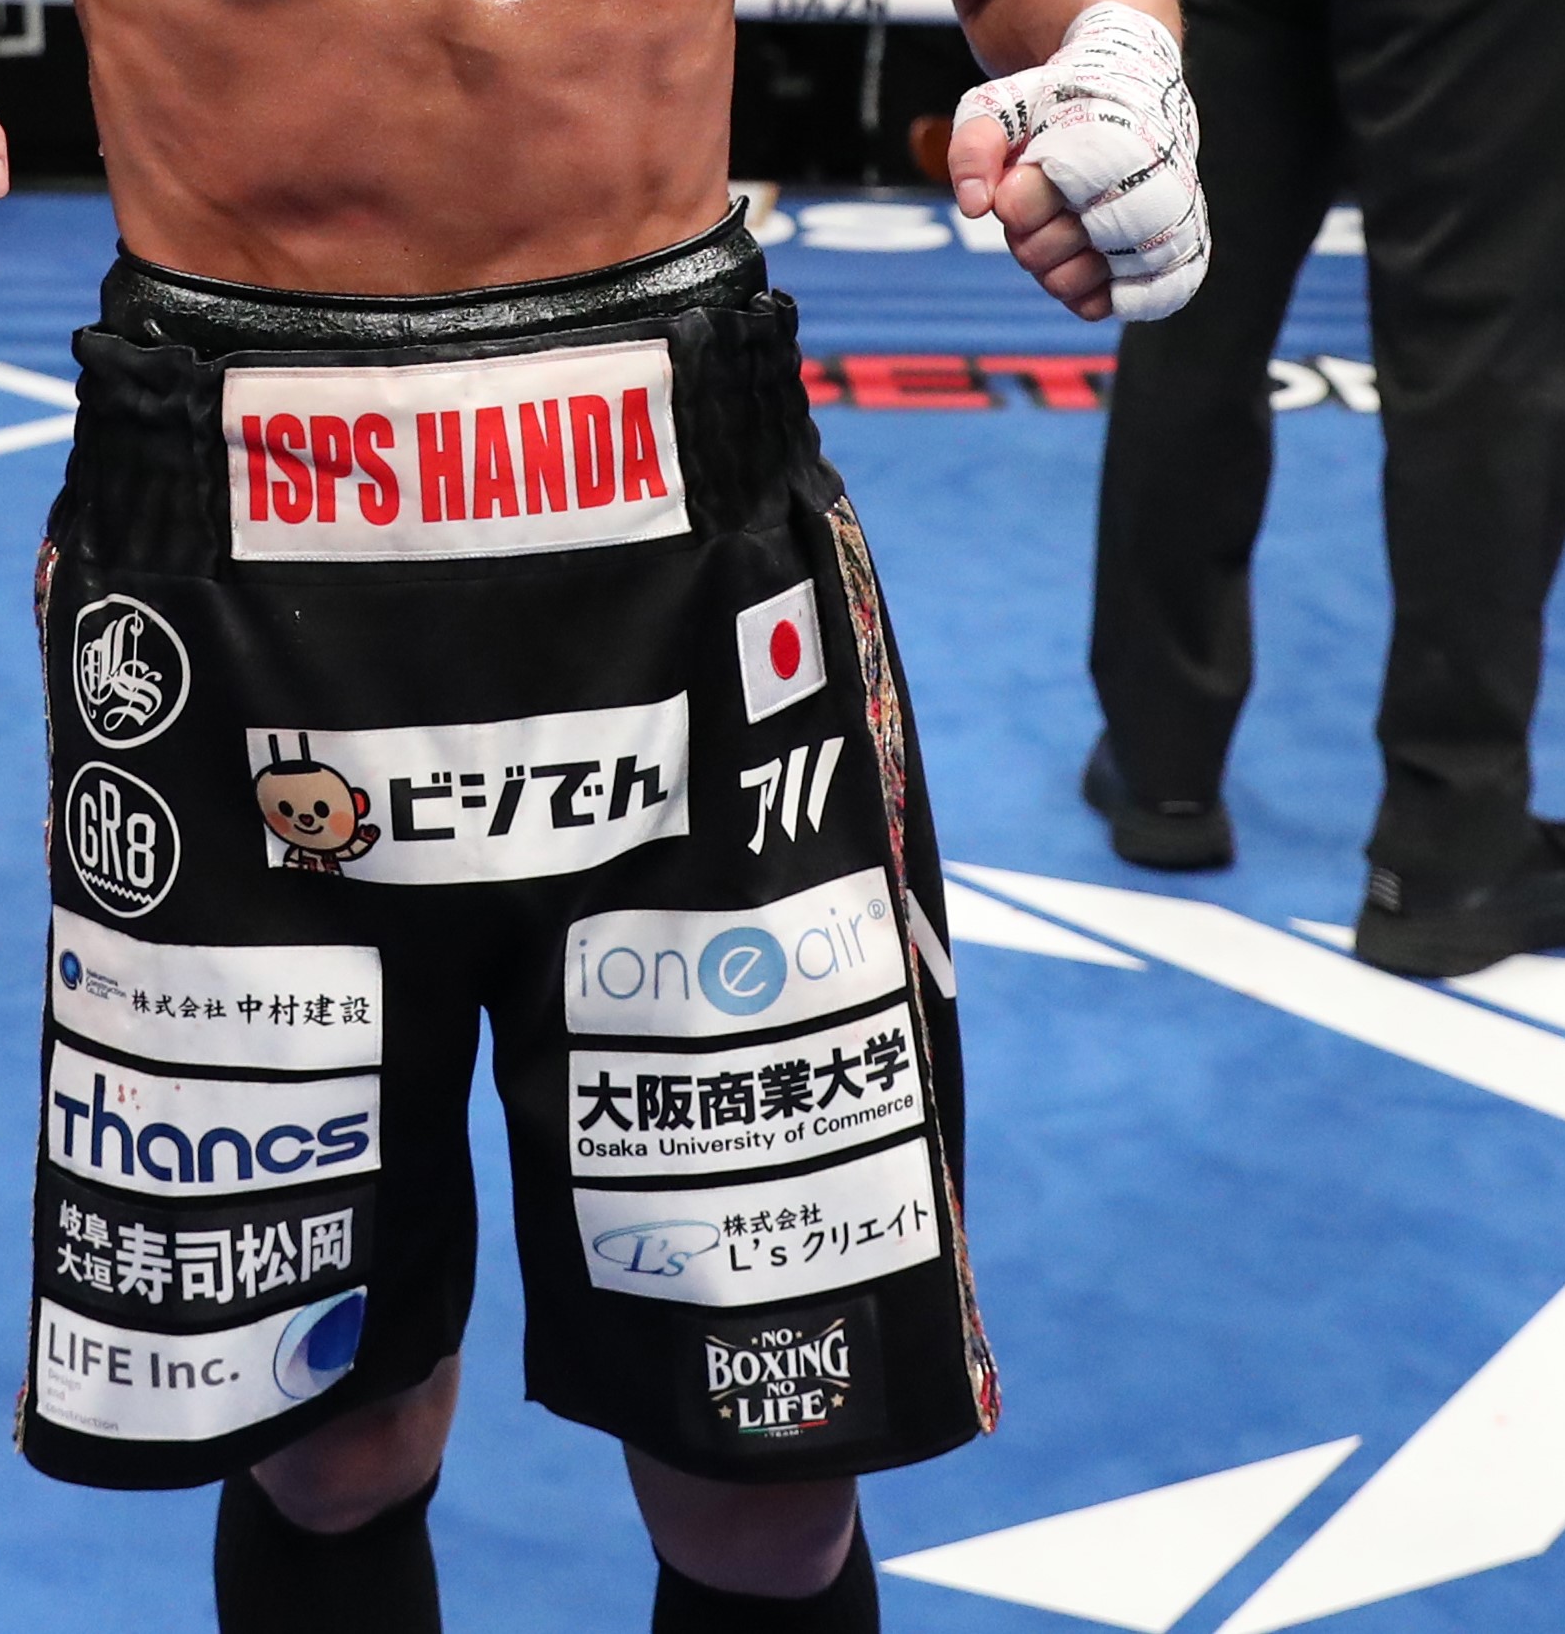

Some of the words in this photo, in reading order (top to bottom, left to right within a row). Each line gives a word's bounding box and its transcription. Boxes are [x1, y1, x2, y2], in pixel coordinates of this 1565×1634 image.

[242, 412, 399, 525] ISPS
[417, 387, 668, 523] HANDA
[389, 755, 669, 842] ビジでん
[79, 779, 157, 889] GR8
[132, 989, 227, 1019] 株式会社
[236, 993, 372, 1026] 中村建設
[577, 1028, 910, 1132] 大阪商業大学
[54, 1073, 370, 1183] Thancs
[578, 1138, 648, 1157] Osaka
[660, 1132, 776, 1157] University
[785, 1122, 805, 1144] of
[813, 1094, 915, 1137] Commerce
[59, 1199, 113, 1249] 岐阜
[722, 1202, 823, 1238] 株式会社
[57, 1242, 114, 1293] 大垣
[116, 1207, 354, 1305] 寿司松岡
[48, 1322, 133, 1386] LIFE
[150, 1352, 240, 1389] Inc.
[705, 1328, 851, 1393] BOXING
[761, 1328, 793, 1348] NO
[736, 1388, 827, 1429] LIFE
[766, 1379, 796, 1398] NO
